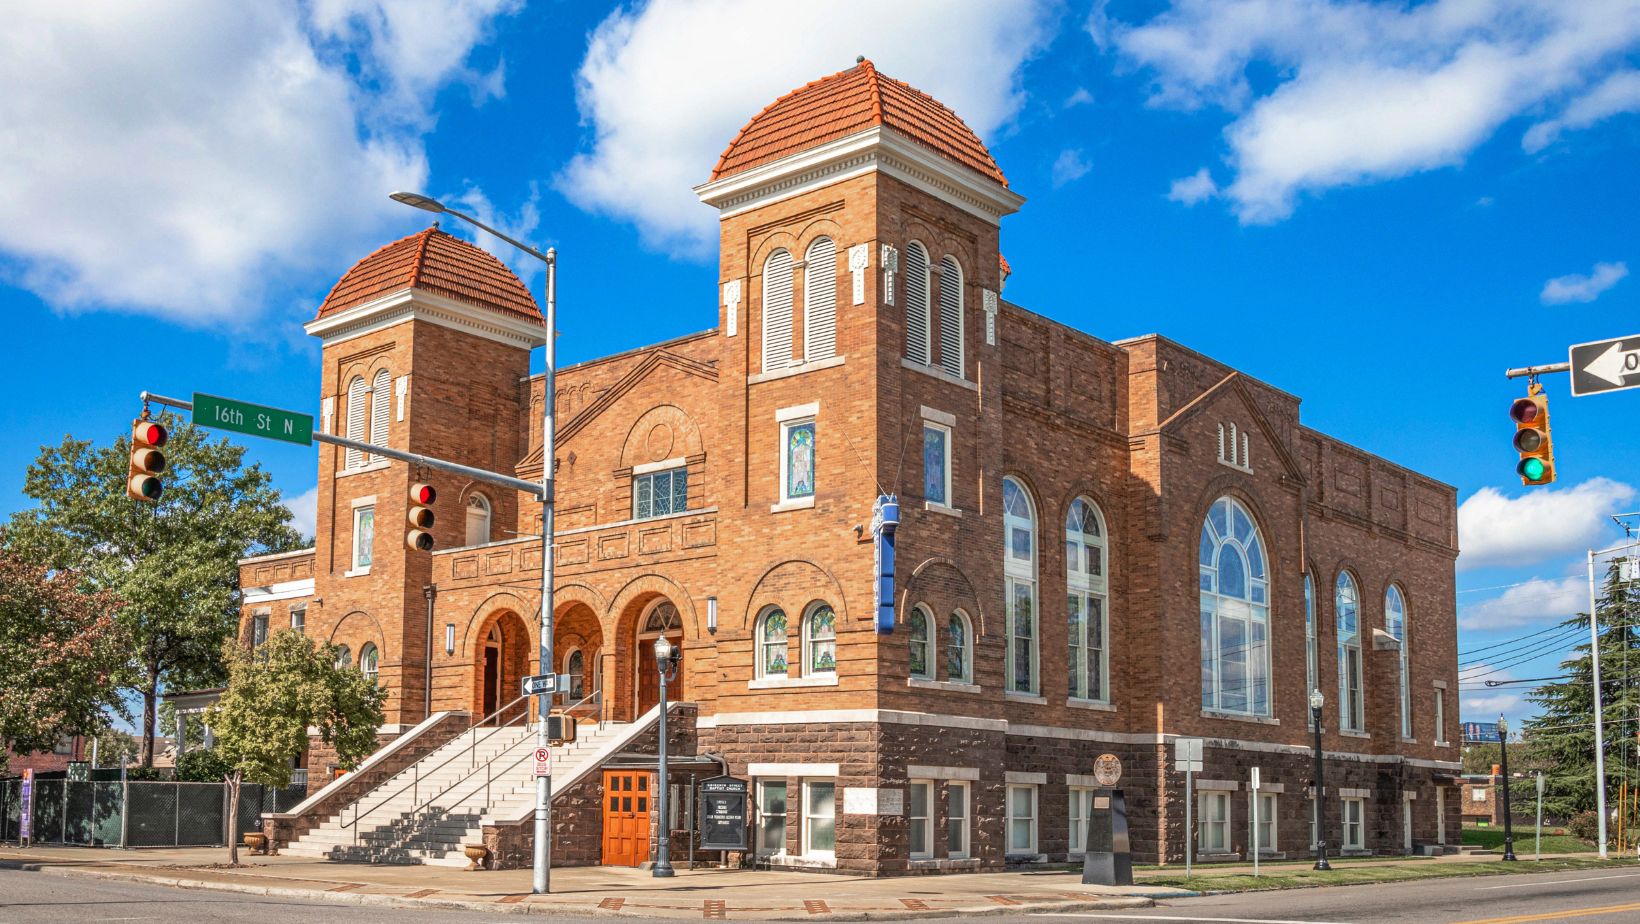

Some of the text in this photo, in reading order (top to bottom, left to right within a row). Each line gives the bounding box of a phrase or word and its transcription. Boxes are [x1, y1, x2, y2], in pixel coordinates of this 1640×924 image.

[1624, 352, 1640, 371] O
[215, 405, 294, 436] 16th St N
